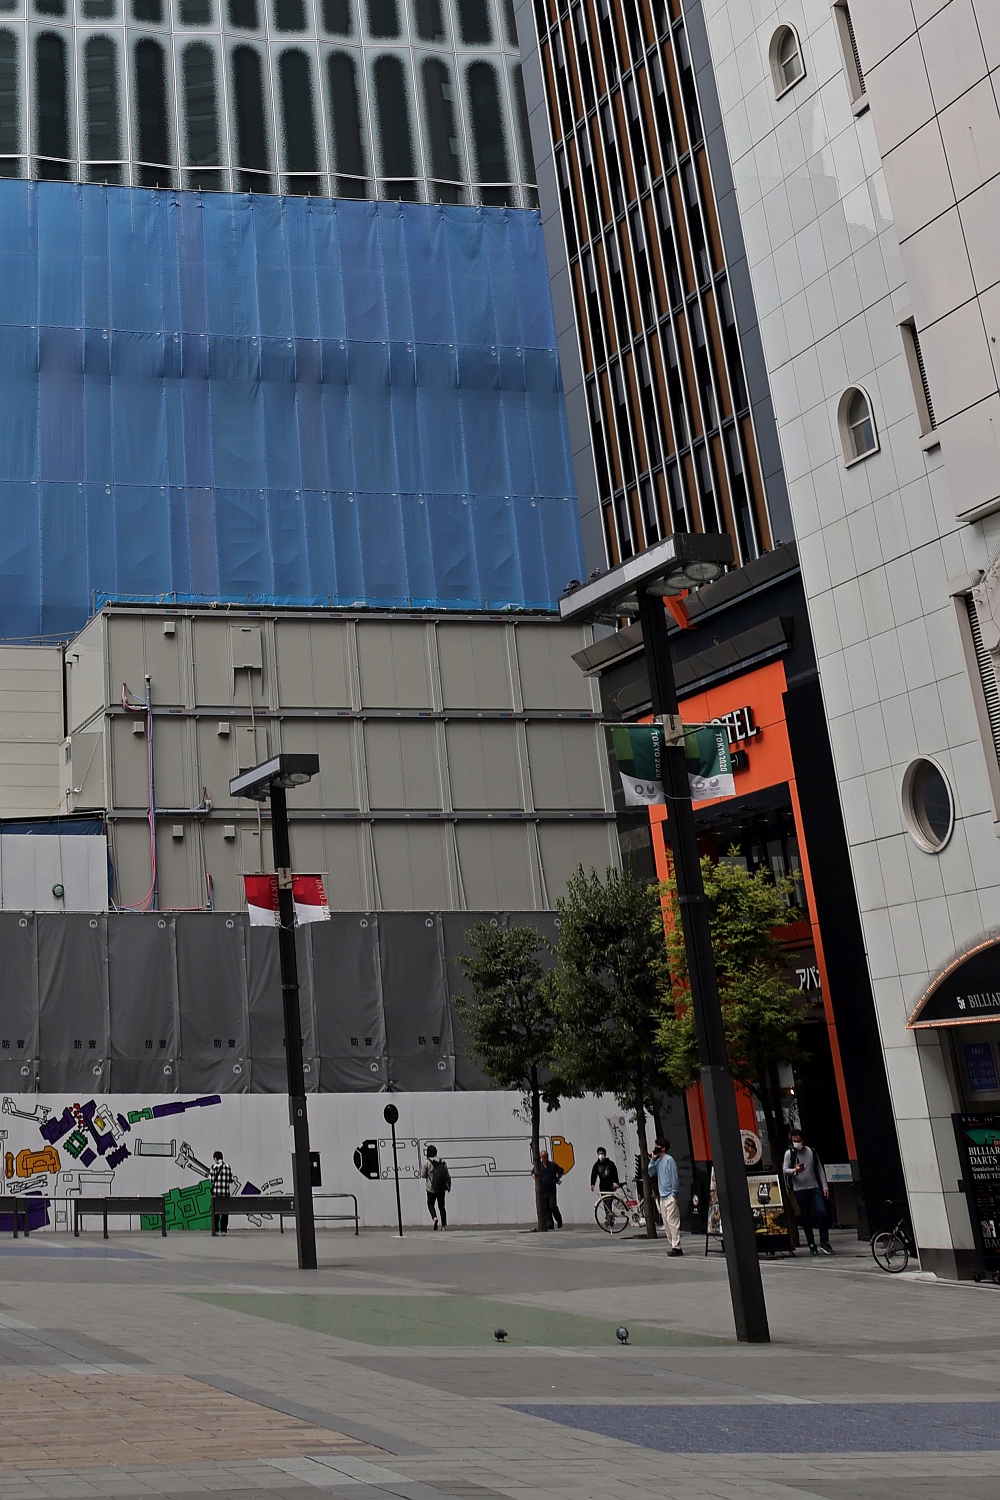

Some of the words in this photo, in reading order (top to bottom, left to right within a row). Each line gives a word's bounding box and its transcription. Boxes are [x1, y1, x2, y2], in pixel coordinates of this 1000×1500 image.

[704, 706, 757, 744] TEL
[650, 731, 661, 757] TOKYO
[715, 733, 725, 756] TOKYO
[654, 758, 662, 778] 2020
[719, 755, 728, 772] 2020
[2, 1039, 25, 1049] 防音
[74, 1039, 97, 1049] 防音
[145, 1039, 167, 1049] 防音
[214, 1038, 236, 1048] 防音
[351, 1037, 372, 1046] 防音
[418, 1036, 440, 1045] 防音
[970, 1156, 998, 1165] DARTS
